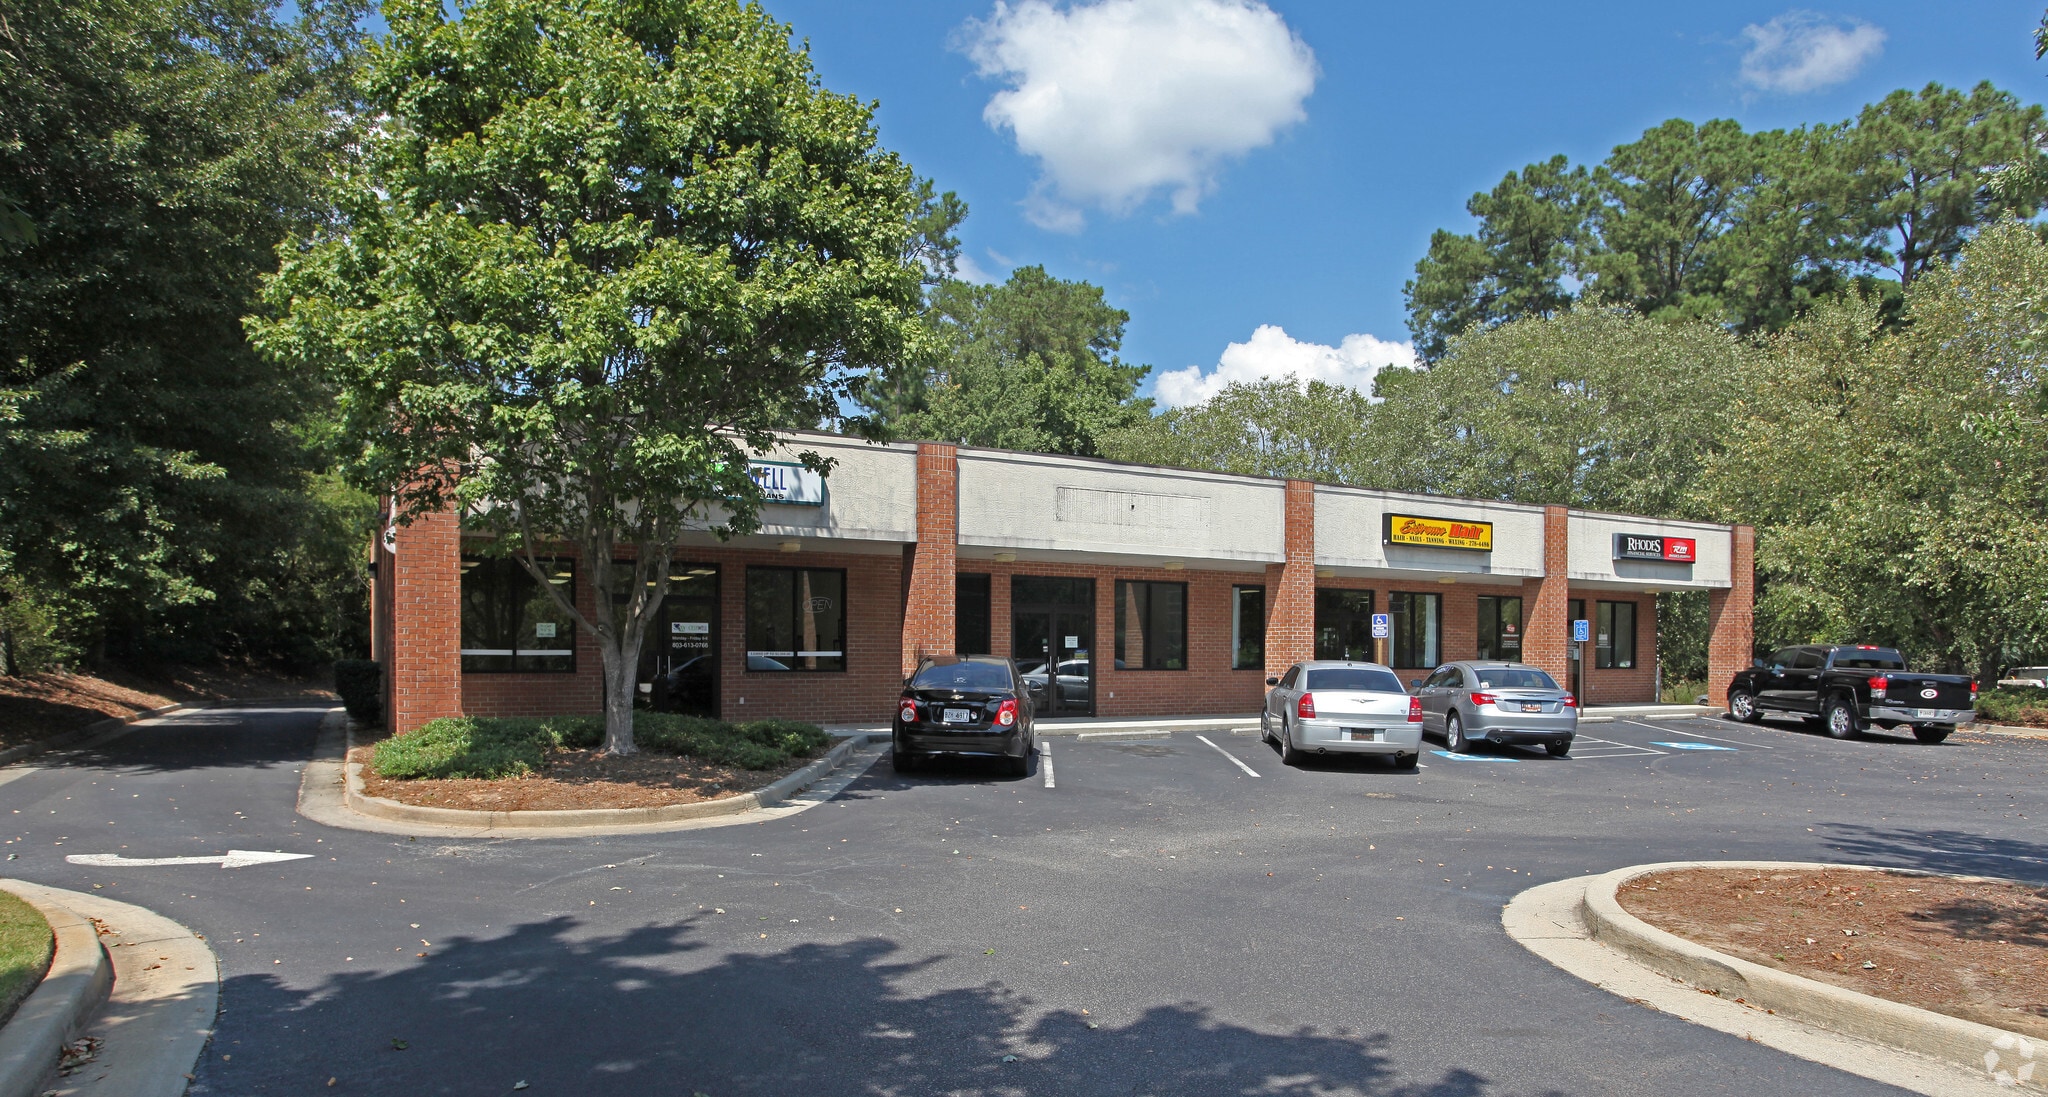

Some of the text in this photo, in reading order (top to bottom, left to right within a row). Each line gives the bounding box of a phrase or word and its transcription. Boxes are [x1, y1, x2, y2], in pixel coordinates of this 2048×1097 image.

[1400, 520, 1483, 539] Extreme Hair
[1426, 537, 1445, 545] TANNING
[1627, 537, 1661, 552] RHODES
[802, 599, 832, 610] OPEN
